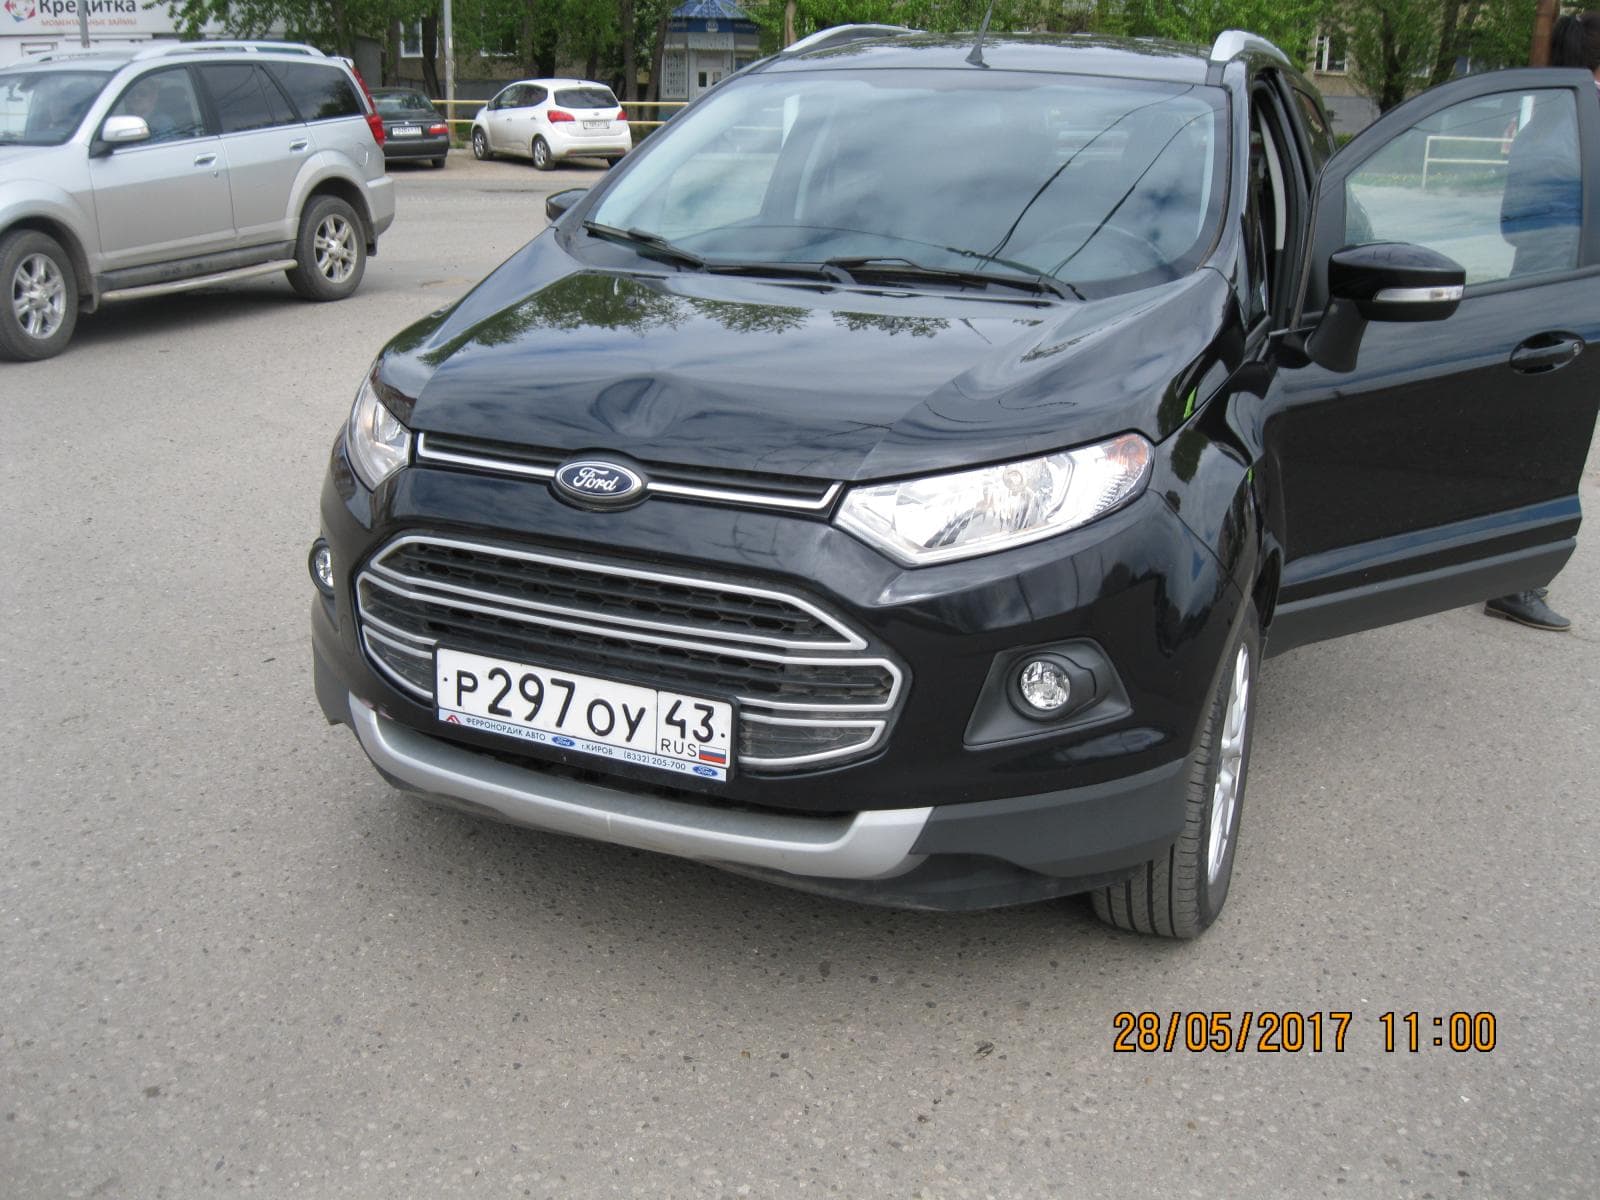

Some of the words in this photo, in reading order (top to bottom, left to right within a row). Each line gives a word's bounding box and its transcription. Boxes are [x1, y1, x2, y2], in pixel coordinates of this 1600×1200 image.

[573, 467, 619, 491] Ford
[465, 717, 523, 736] ФЕРРОНОРДИК
[525, 731, 546, 741] АВТО
[665, 700, 714, 743] 43
[660, 738, 697, 758] RUS
[623, 752, 650, 764] (8332)
[652, 757, 686, 770] 205-700
